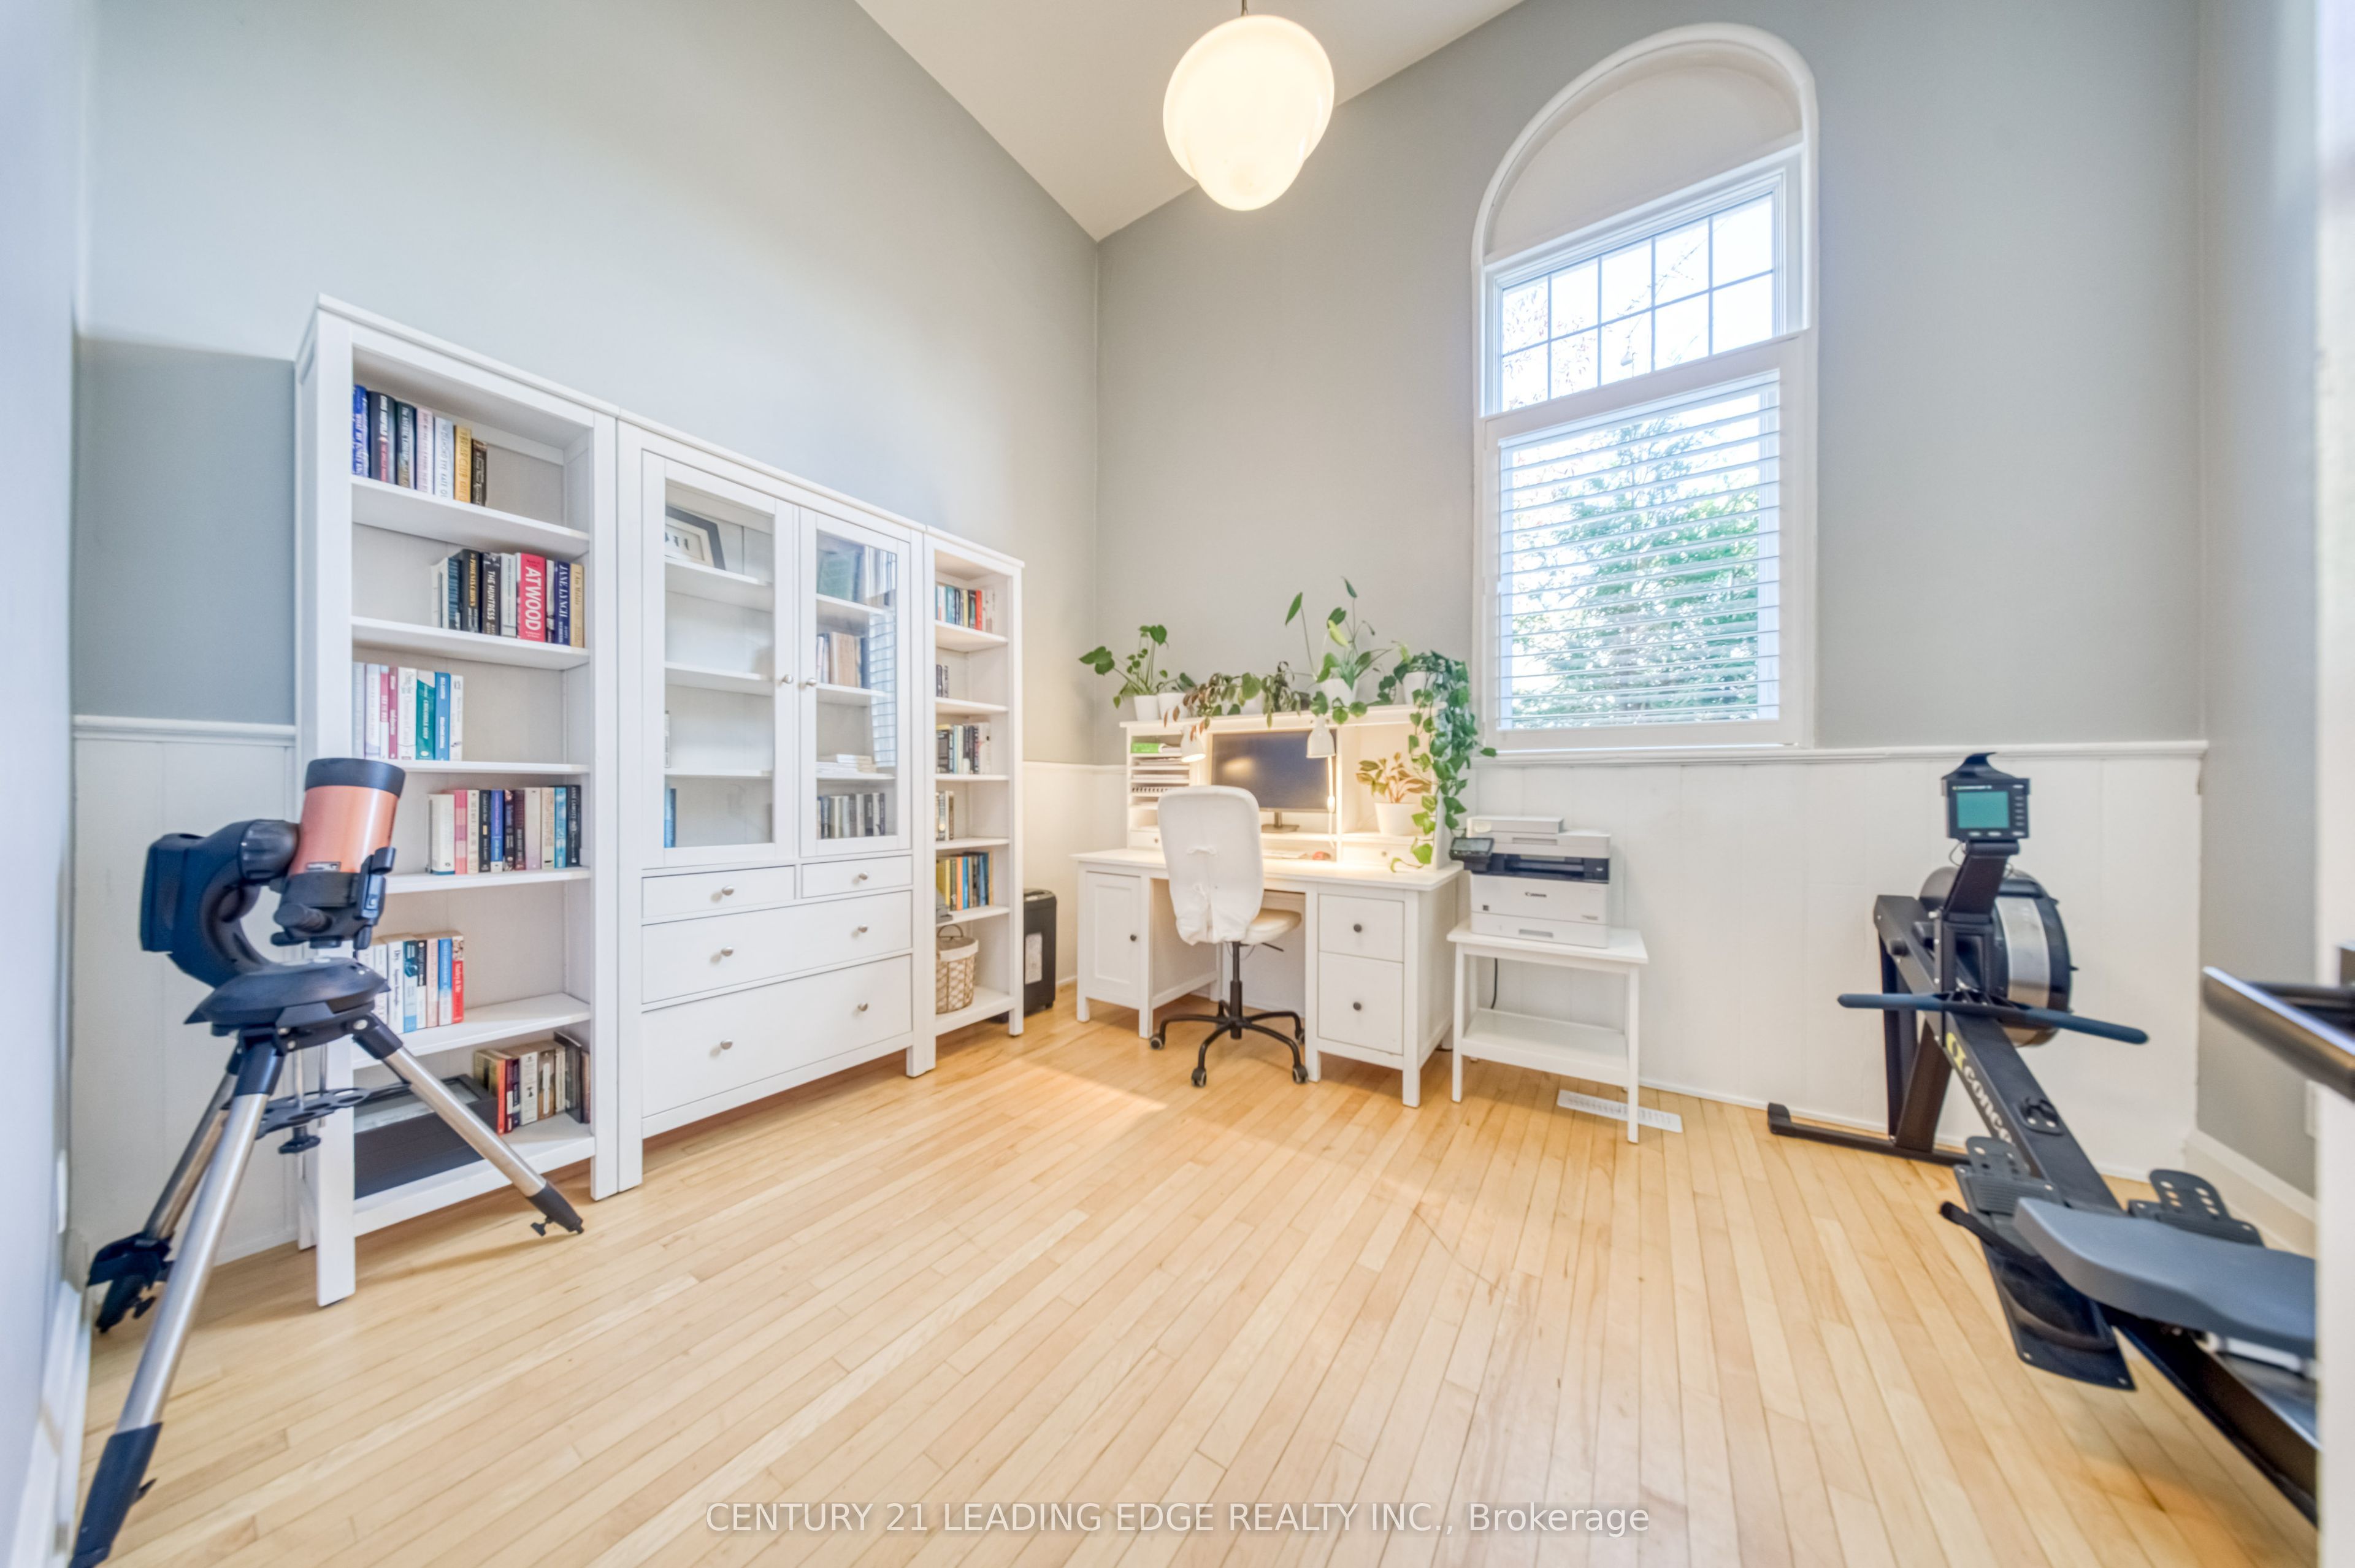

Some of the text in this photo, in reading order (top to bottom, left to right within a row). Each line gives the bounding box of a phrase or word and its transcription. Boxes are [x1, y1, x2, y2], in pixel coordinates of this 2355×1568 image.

[459, 458, 469, 478] CLUB
[524, 566, 542, 631] ATWOOD
[559, 564, 569, 618] JANE LYNCH
[1964, 1066, 2012, 1144] conce
